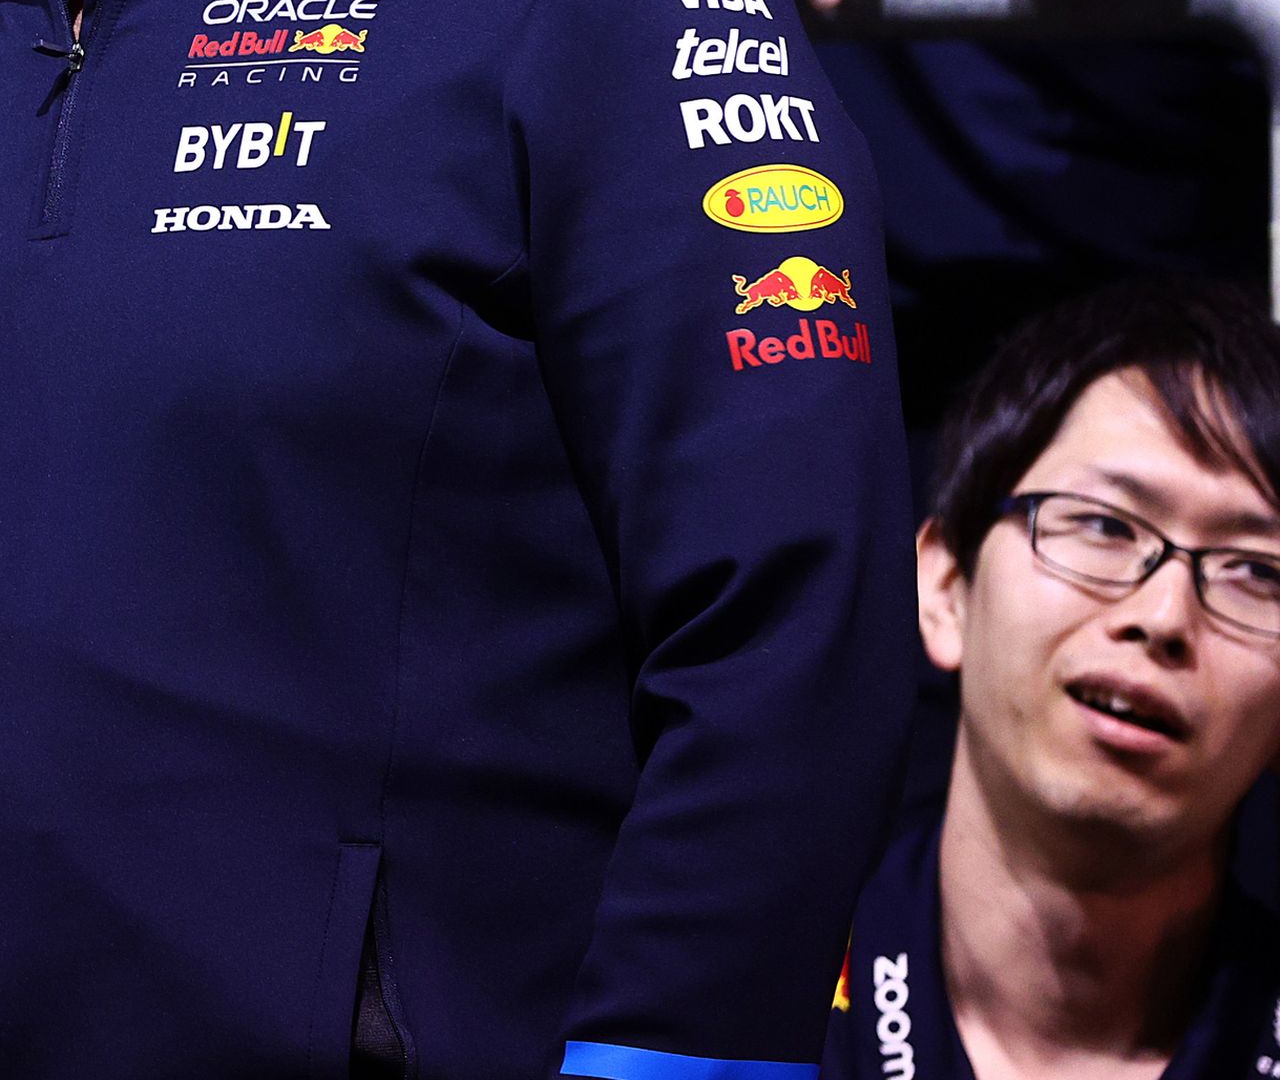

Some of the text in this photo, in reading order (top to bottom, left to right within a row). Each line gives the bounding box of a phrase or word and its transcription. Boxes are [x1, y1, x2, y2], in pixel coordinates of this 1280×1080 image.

[188, 29, 289, 58] Red Bull
[671, 28, 789, 80] telcel
[177, 66, 360, 88] RACING
[173, 111, 327, 173] BYBIT
[679, 93, 820, 150] ROKT
[151, 204, 331, 234] HONDA
[746, 184, 831, 214] RAUCH
[725, 319, 872, 371] Red Bull
[874, 952, 915, 1080] zoom
